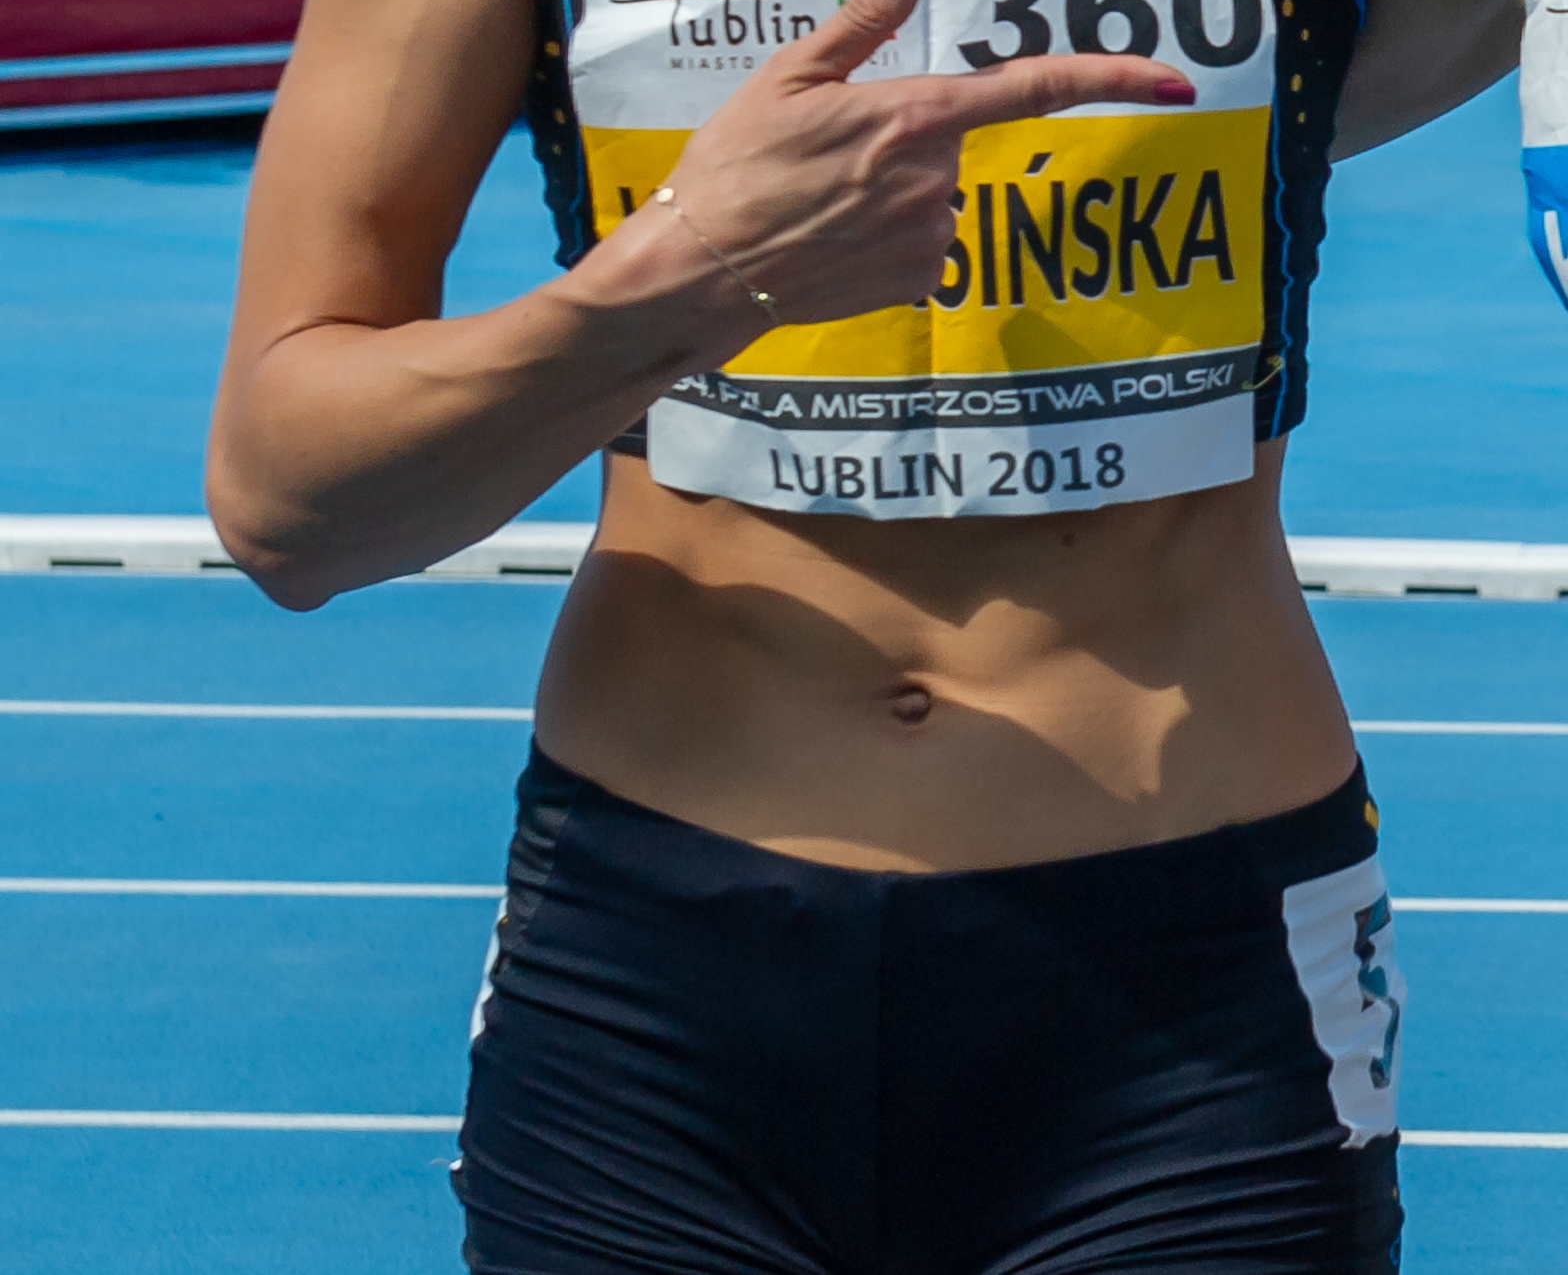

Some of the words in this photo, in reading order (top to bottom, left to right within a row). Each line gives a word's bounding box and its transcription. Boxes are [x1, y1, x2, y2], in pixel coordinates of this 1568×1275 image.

[912, 153, 1236, 312] SIŃSKA
[810, 381, 1106, 421] MISTRZOSTWA
[1111, 362, 1236, 405] POLSKI
[769, 448, 964, 500] LUBLIN
[987, 442, 1127, 498] 2018
